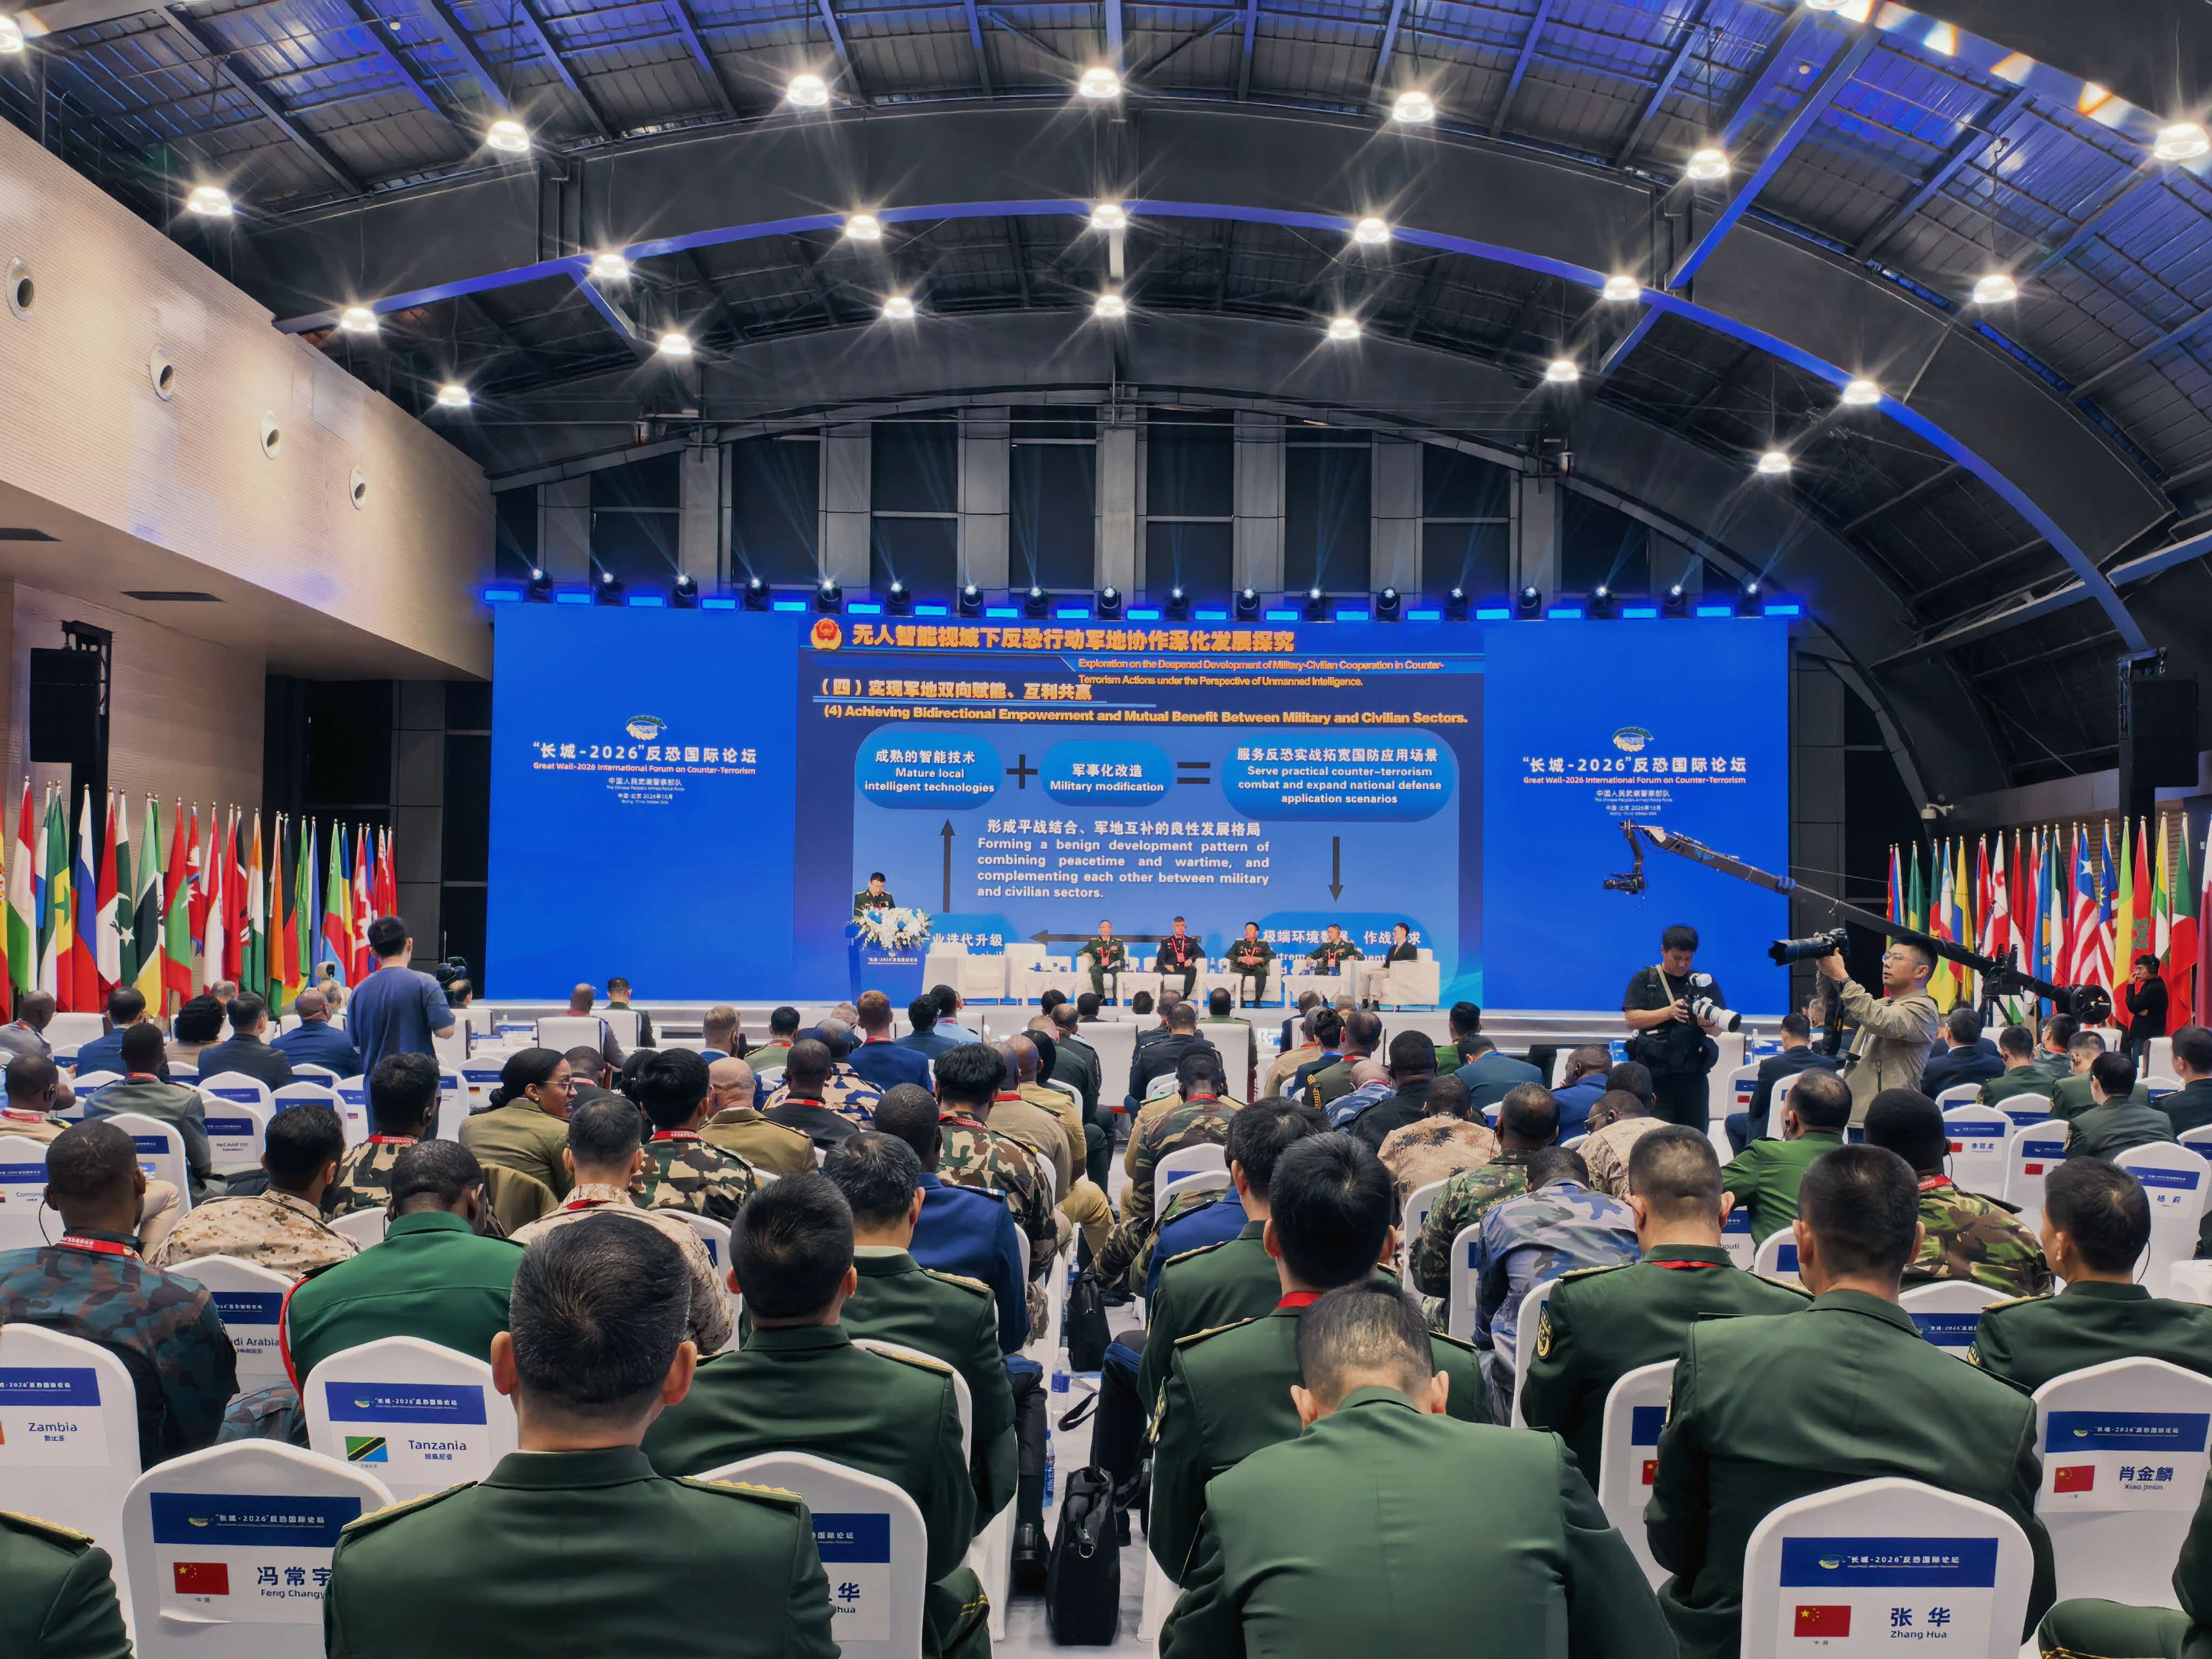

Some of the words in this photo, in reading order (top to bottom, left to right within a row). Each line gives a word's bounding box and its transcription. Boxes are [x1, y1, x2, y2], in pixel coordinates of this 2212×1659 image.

[852, 624, 1294, 652] 无人智能视域下反恐行动军地协作深化发展探究
[1078, 659, 1128, 669] Exploration
[1143, 660, 1156, 669] the
[1158, 660, 1202, 670] Deepened
[1204, 660, 1261, 671] Development
[1263, 661, 1273, 669] of
[1339, 661, 1393, 671] Cooperation
[1395, 661, 1403, 669] in
[1405, 662, 1444, 670] Counter-
[1078, 675, 1121, 684] Terrorism
[1123, 675, 1156, 685] Actions
[1158, 676, 1182, 685] under
[1184, 676, 1197, 685] the
[1199, 676, 1251, 687] Perspective
[1252, 677, 1262, 685] of
[1263, 677, 1311, 686] Unmanned
[1313, 677, 1363, 687] Intelligence.
[824, 705, 842, 718] (4)
[845, 705, 910, 719] Achieving
[913, 706, 996, 719] Bidirectional
[999, 709, 1094, 722] Empowerment
[1097, 710, 1122, 721] and
[1124, 711, 1169, 722] Mutual
[1172, 711, 1219, 723] Benefit
[1222, 712, 1280, 723] Between
[1283, 711, 1331, 725] Military
[1334, 712, 1359, 724] and
[1361, 712, 1410, 724] Civilian
[1412, 712, 1468, 724] Sectors.
[875, 749, 976, 764] 成熟的智能技术
[1237, 748, 1439, 763] 服务反恐实战拓宽国防应用场景
[533, 761, 555, 770] Great
[556, 763, 596, 771] Wall-2026
[598, 764, 648, 772] International
[687, 766, 756, 775] Counter-Terrorism
[895, 767, 936, 778] Mature
[939, 768, 965, 778] local
[1072, 764, 1143, 778] 军事化改造
[1247, 766, 1279, 775] Serve
[1282, 766, 1329, 778] practical
[865, 781, 921, 793] intelligent
[924, 783, 995, 794] technologies
[1050, 780, 1094, 792] Military
[1095, 782, 1164, 791] modification
[1238, 780, 1280, 790] combat
[1283, 780, 1303, 790] and
[1306, 780, 1347, 791] expand
[1350, 781, 1395, 790] national
[1398, 780, 1442, 790] defense
[1281, 793, 1342, 805] application
[1345, 794, 1398, 804] scenarios
[987, 819, 1261, 837] 形成平战结合、军地互补的良性发展格局
[978, 838, 1032, 852] Forming
[1040, 841, 1048, 849] a
[1056, 839, 1100, 852] benign
[1109, 839, 1192, 853] development
[1201, 841, 1248, 854] pattern
[1257, 841, 1270, 852] of
[977, 854, 1046, 867] combining
[1059, 855, 1125, 867] peacetime
[1138, 856, 1162, 867] and
[1175, 857, 1232, 869] wartime,
[1245, 857, 1269, 868] and
[977, 870, 1078, 884] complementing
[1084, 871, 1114, 882] each
[1119, 872, 1154, 882] other
[1158, 872, 1214, 883] between
[1219, 873, 1269, 886] military
[977, 886, 1001, 897] and
[1004, 886, 1050, 898] civilian
[1054, 887, 1104, 898] sectors.
[921, 933, 1003, 947] 业迭代升级
[28, 1422, 78, 1432] Zambia
[407, 1440, 467, 1451] Tanzania
[2119, 1465, 2174, 1482] 肖金麟
[261, 1589, 285, 1599] Feng
[288, 1589, 325, 1599] Changy
[1891, 1607, 1951, 1627] 张华
[1891, 1630, 1923, 1641] Zhang
[1926, 1630, 1947, 1639] Hua
